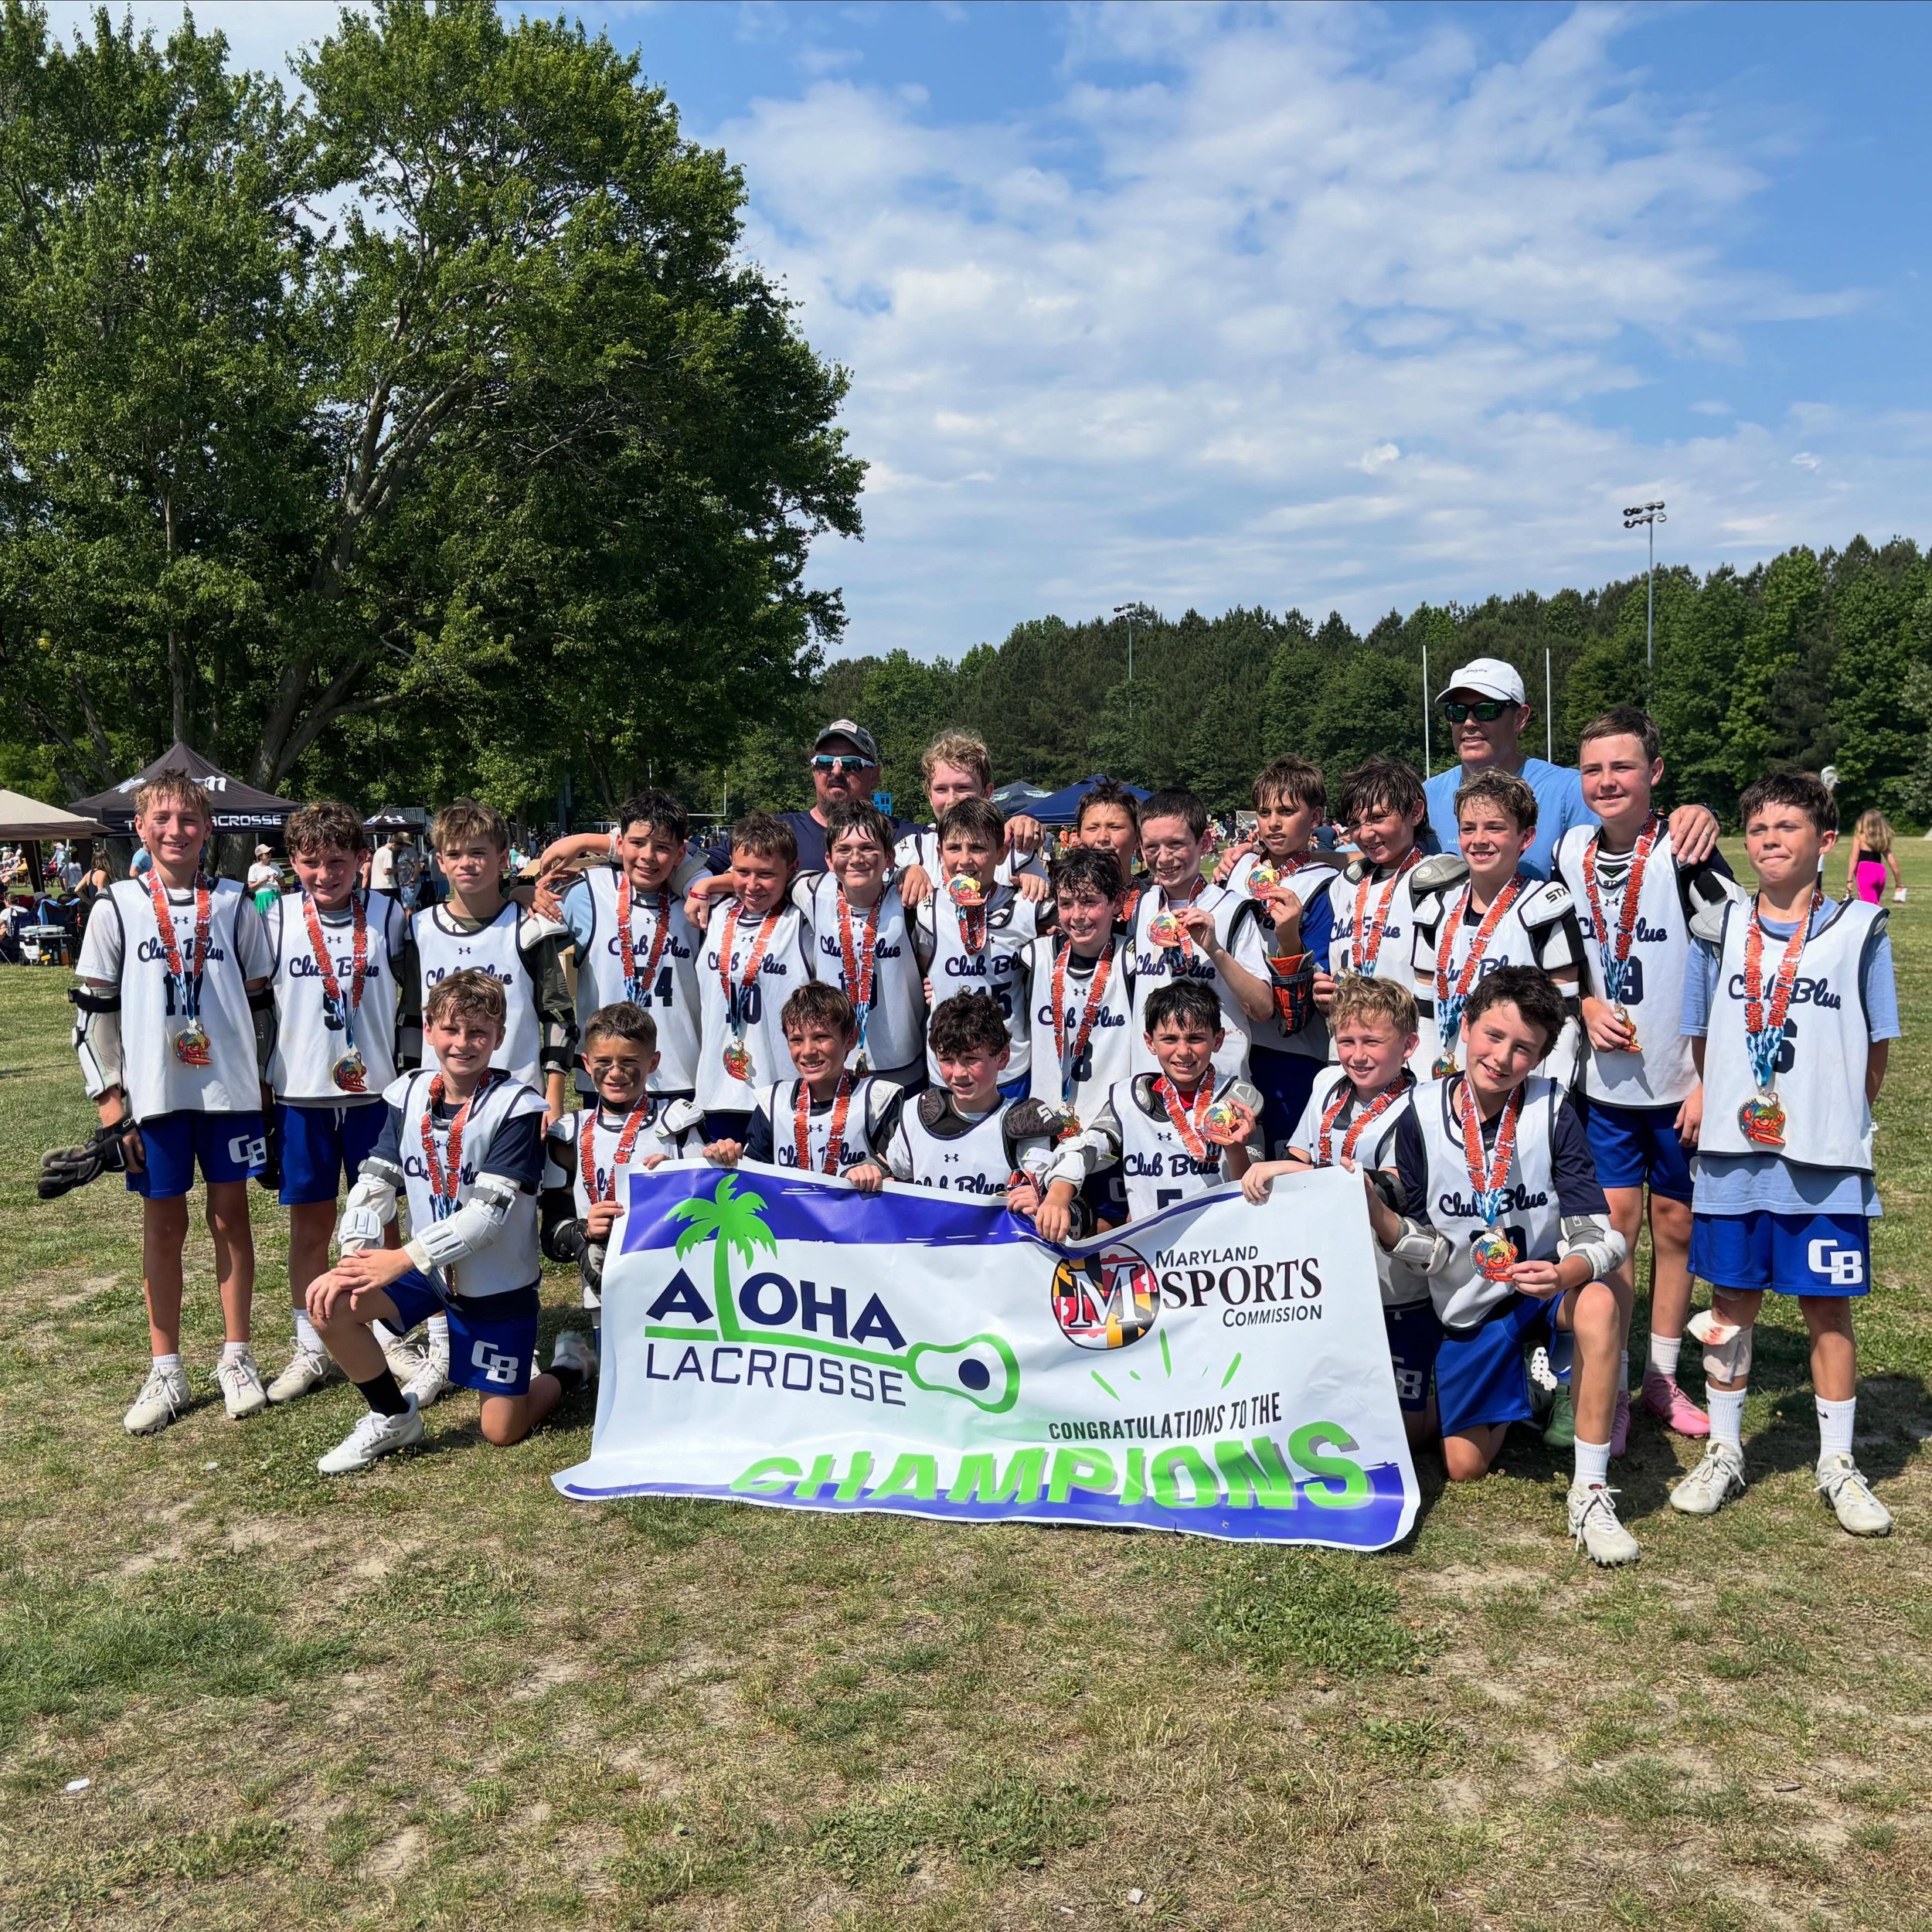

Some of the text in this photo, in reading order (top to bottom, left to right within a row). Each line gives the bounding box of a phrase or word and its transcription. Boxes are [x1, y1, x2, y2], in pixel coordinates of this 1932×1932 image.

[1545, 886, 1570, 903] STX
[1363, 917, 1401, 939] Bue
[1614, 917, 1668, 943] lue
[608, 934, 648, 957] Cub
[857, 937, 901, 959] lue
[289, 957, 379, 978] Clu Bue
[467, 964, 513, 985] lue
[708, 951, 787, 976] Clb lue
[944, 951, 1022, 978] Club Bl
[1171, 954, 1216, 980] lue
[228, 1134, 267, 1168] CB
[1124, 1151, 1220, 1177] Club Blue
[1439, 1192, 1482, 1218] Clu
[1155, 1244, 1260, 1270] MARYLAND
[1808, 1239, 1863, 1284] CB
[1162, 1257, 1323, 1310] SPORTS
[645, 1261, 908, 1351] ALOHA
[1221, 1304, 1323, 1328] COMMISSION
[471, 1340, 519, 1384] CB
[645, 1342, 907, 1407] LACROSSE
[1391, 1355, 1423, 1400] B
[1047, 1392, 1283, 1440] CONGRATULATIONS TO THE
[730, 1420, 1374, 1510] CHAMPIONS
